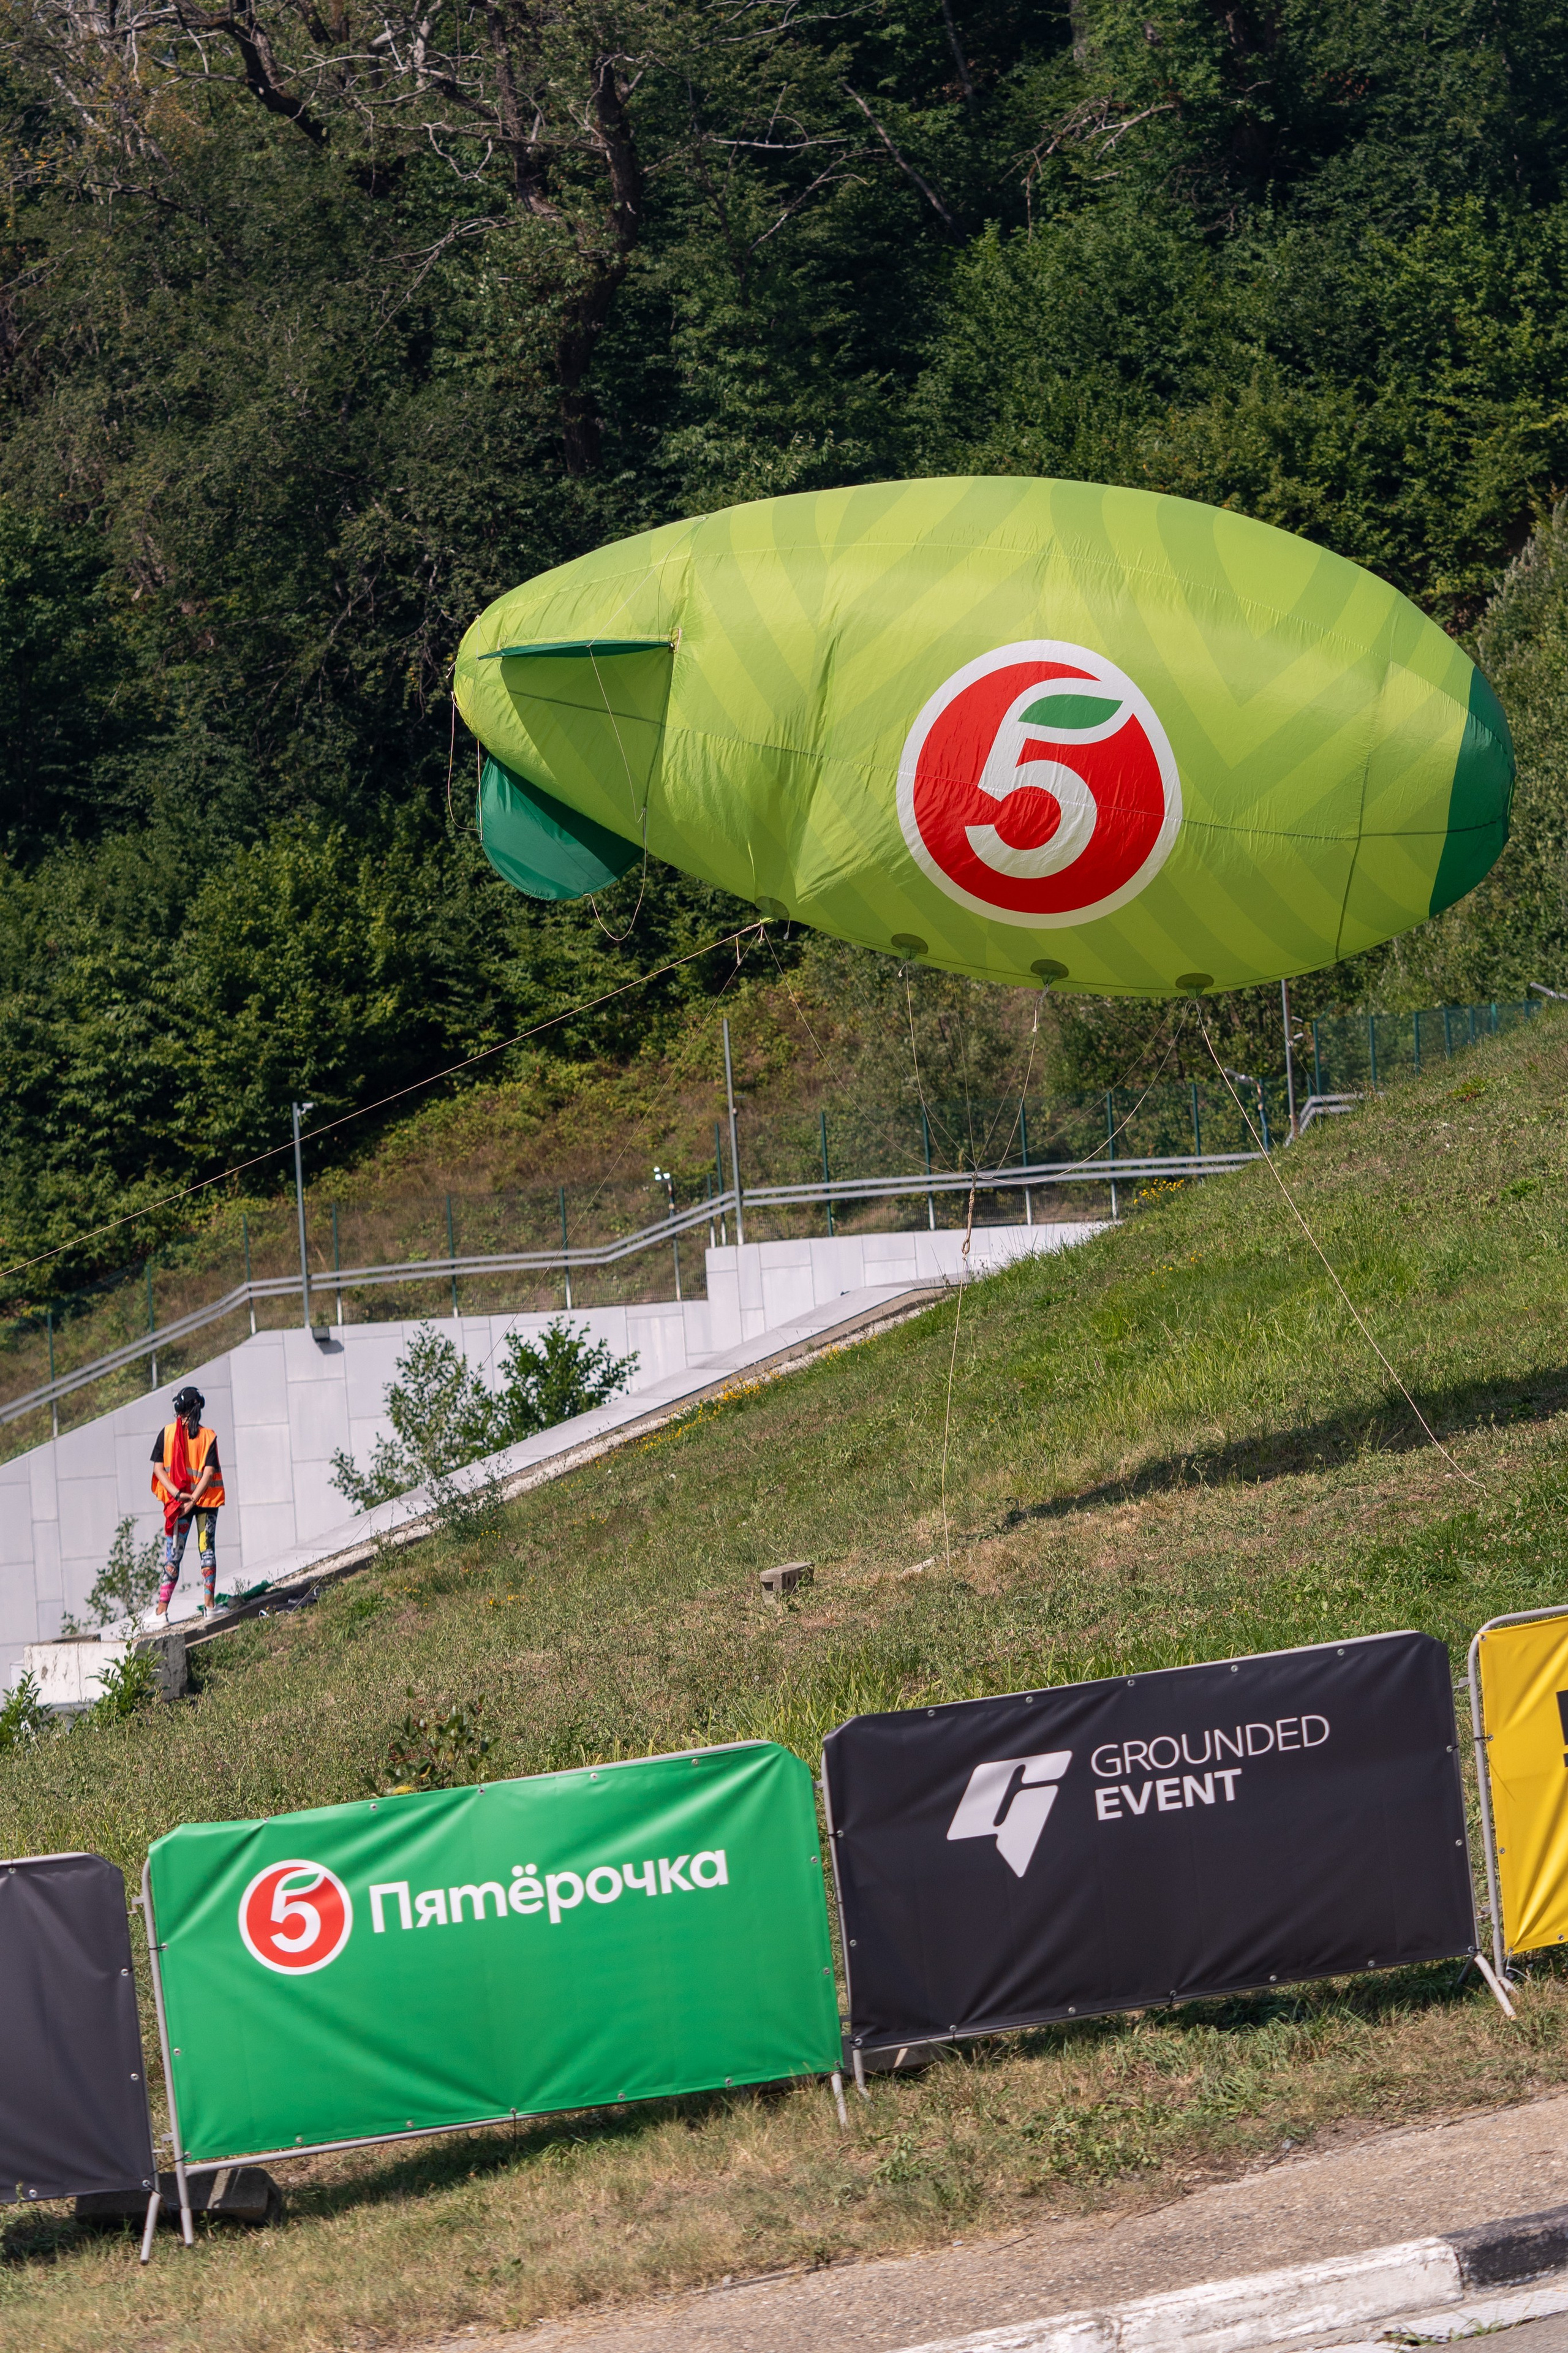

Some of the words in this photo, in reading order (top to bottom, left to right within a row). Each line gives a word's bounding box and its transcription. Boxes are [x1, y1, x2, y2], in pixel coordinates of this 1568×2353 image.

[965, 678, 1133, 879] 5
[1091, 1715, 1330, 1777] GROUNDED
[1095, 1768, 1242, 1821] EVENT
[270, 1867, 326, 1953] 5
[369, 1849, 729, 1933] Пятёрочка
